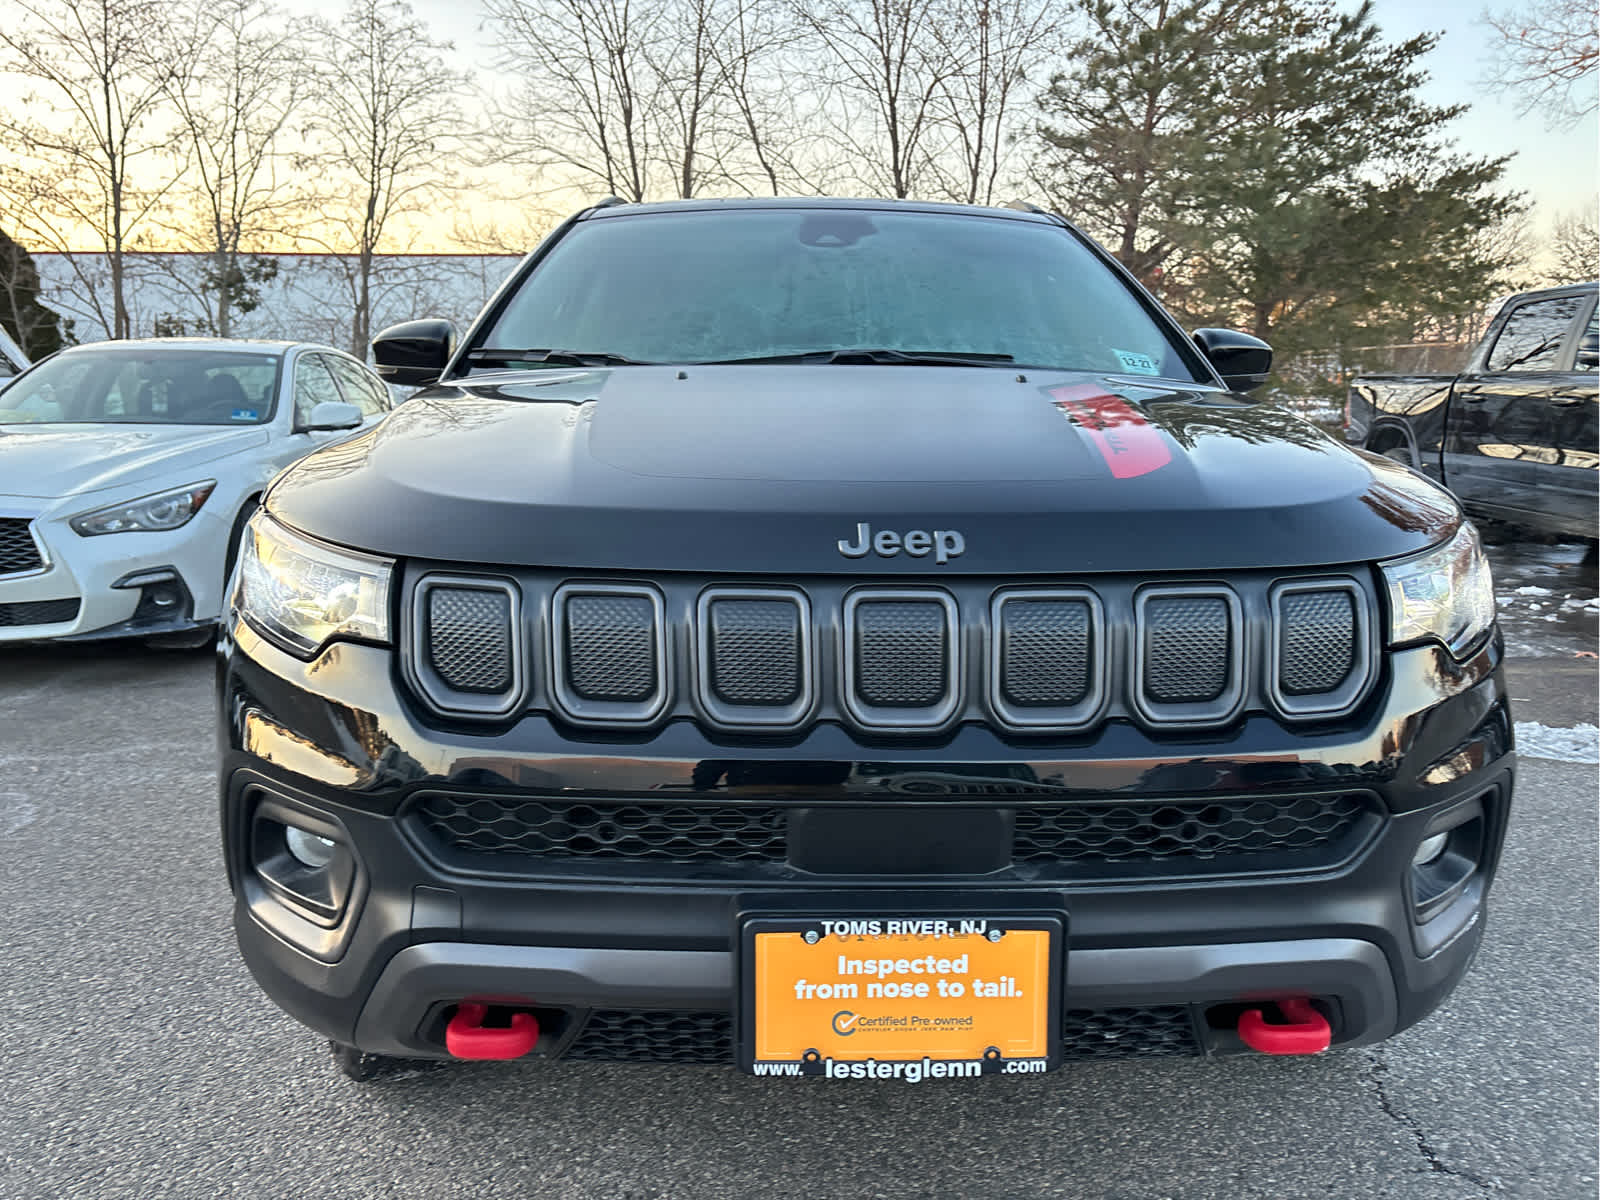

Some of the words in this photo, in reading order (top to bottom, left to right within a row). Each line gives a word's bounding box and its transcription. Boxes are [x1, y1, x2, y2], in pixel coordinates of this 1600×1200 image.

[837, 522, 965, 565] Jeep
[821, 920, 881, 936] TOMS
[887, 920, 955, 938] RIVER,
[960, 920, 987, 934] NJ
[837, 954, 969, 979] Inspected
[794, 980, 858, 999] from
[866, 980, 930, 998] nose
[937, 979, 966, 997] to
[973, 976, 1023, 998] tail.
[857, 1015, 908, 1026] Certified
[753, 1063, 804, 1076] www.
[825, 1058, 982, 1083] lesterglenn
[1001, 1059, 1047, 1074] .com
